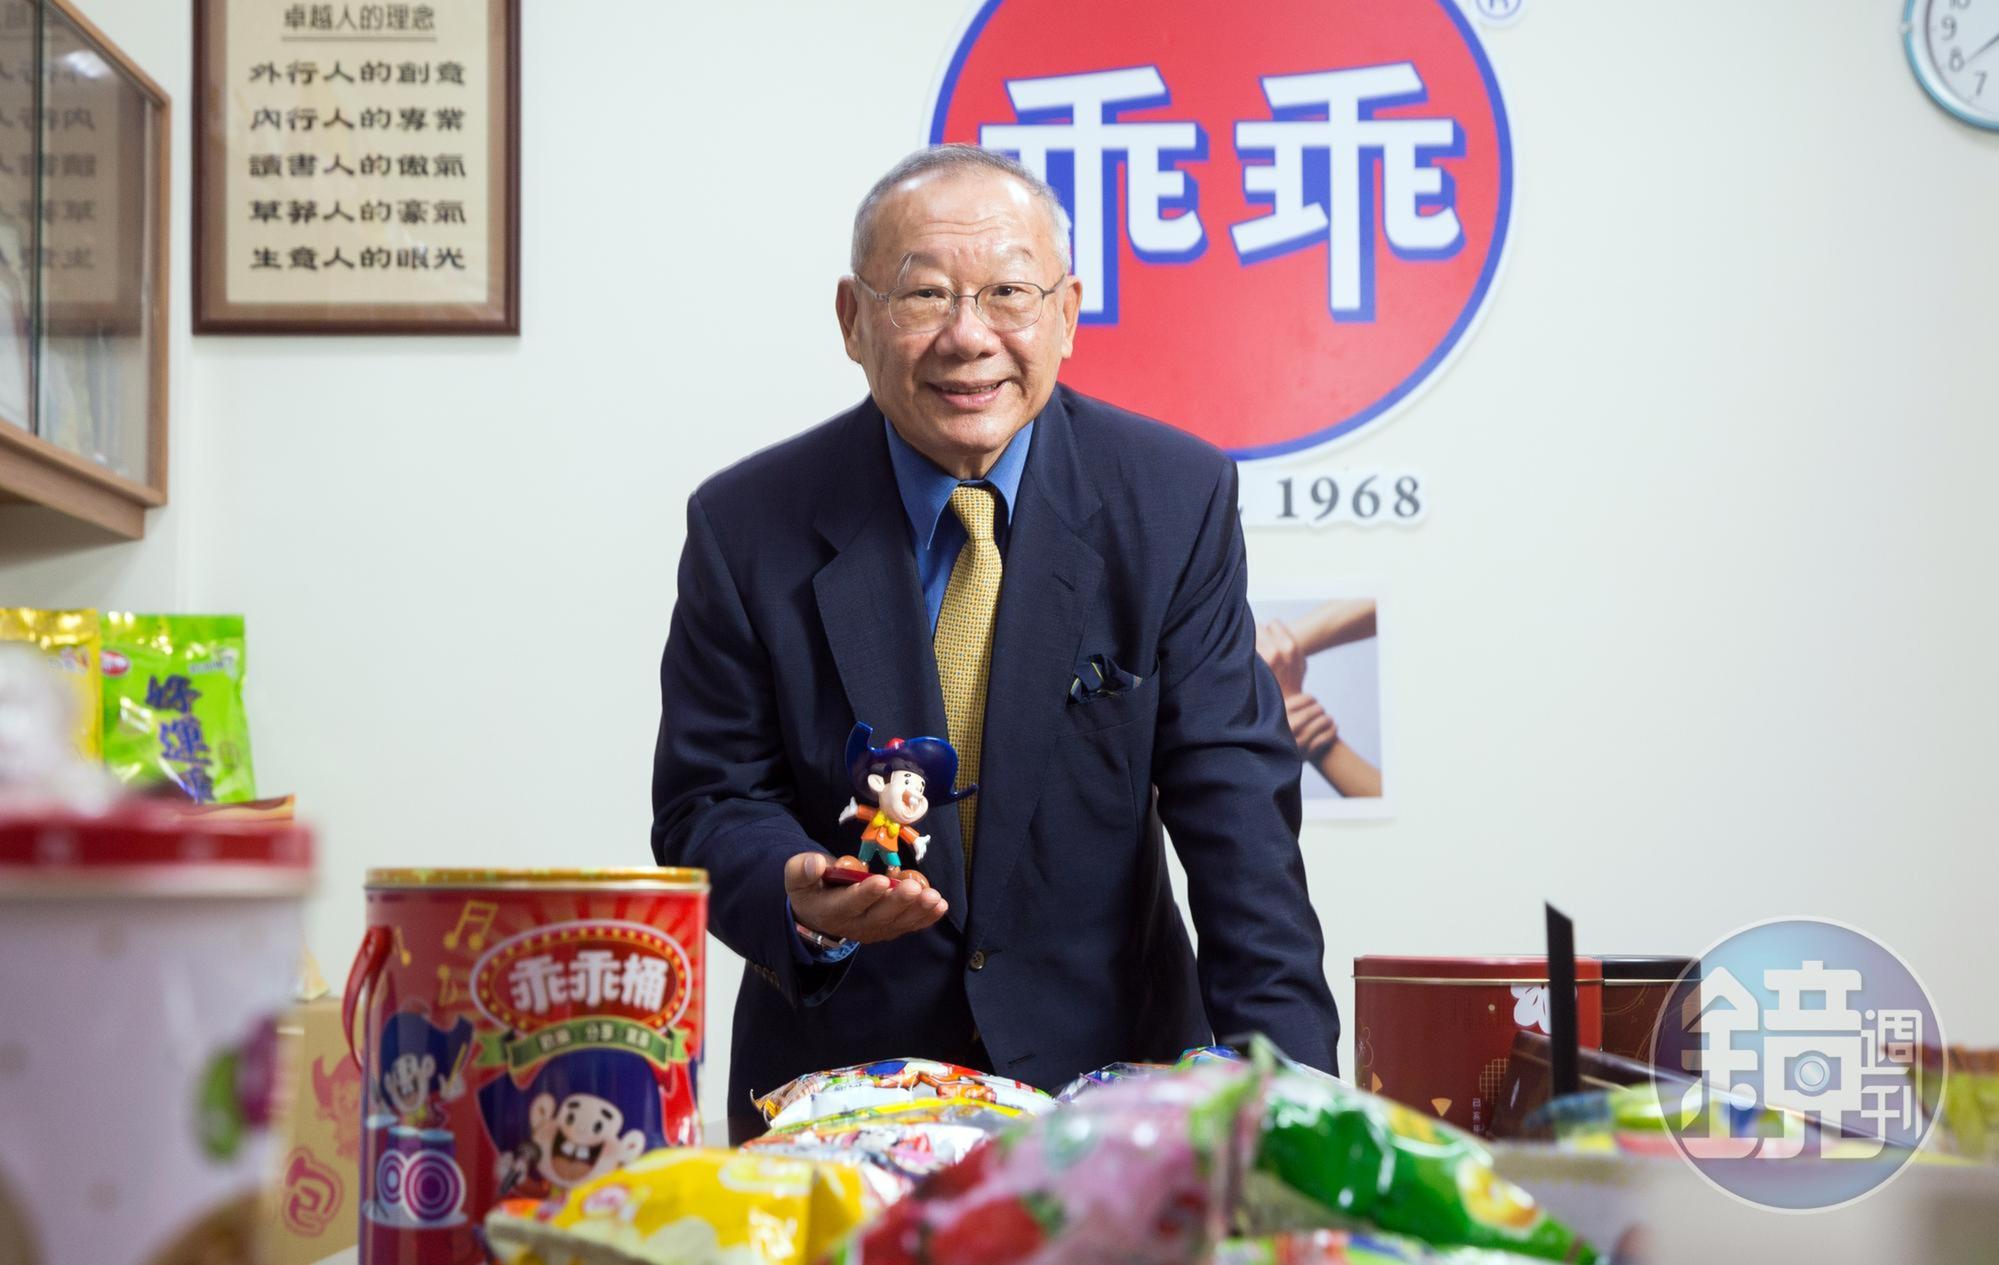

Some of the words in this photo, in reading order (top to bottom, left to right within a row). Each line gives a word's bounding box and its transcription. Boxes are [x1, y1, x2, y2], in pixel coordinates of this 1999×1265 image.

[284, 3, 435, 31] 卓越人的理念
[1941, 15, 1957, 41] 9
[248, 61, 466, 86] 外行人的創意
[980, 61, 1467, 325] 乖乖
[249, 200, 466, 224] 草莽人的豪氣
[249, 247, 466, 271] 生意人的眼光
[1277, 475, 1421, 520] 1968
[508, 950, 669, 1014] 乖乖桶
